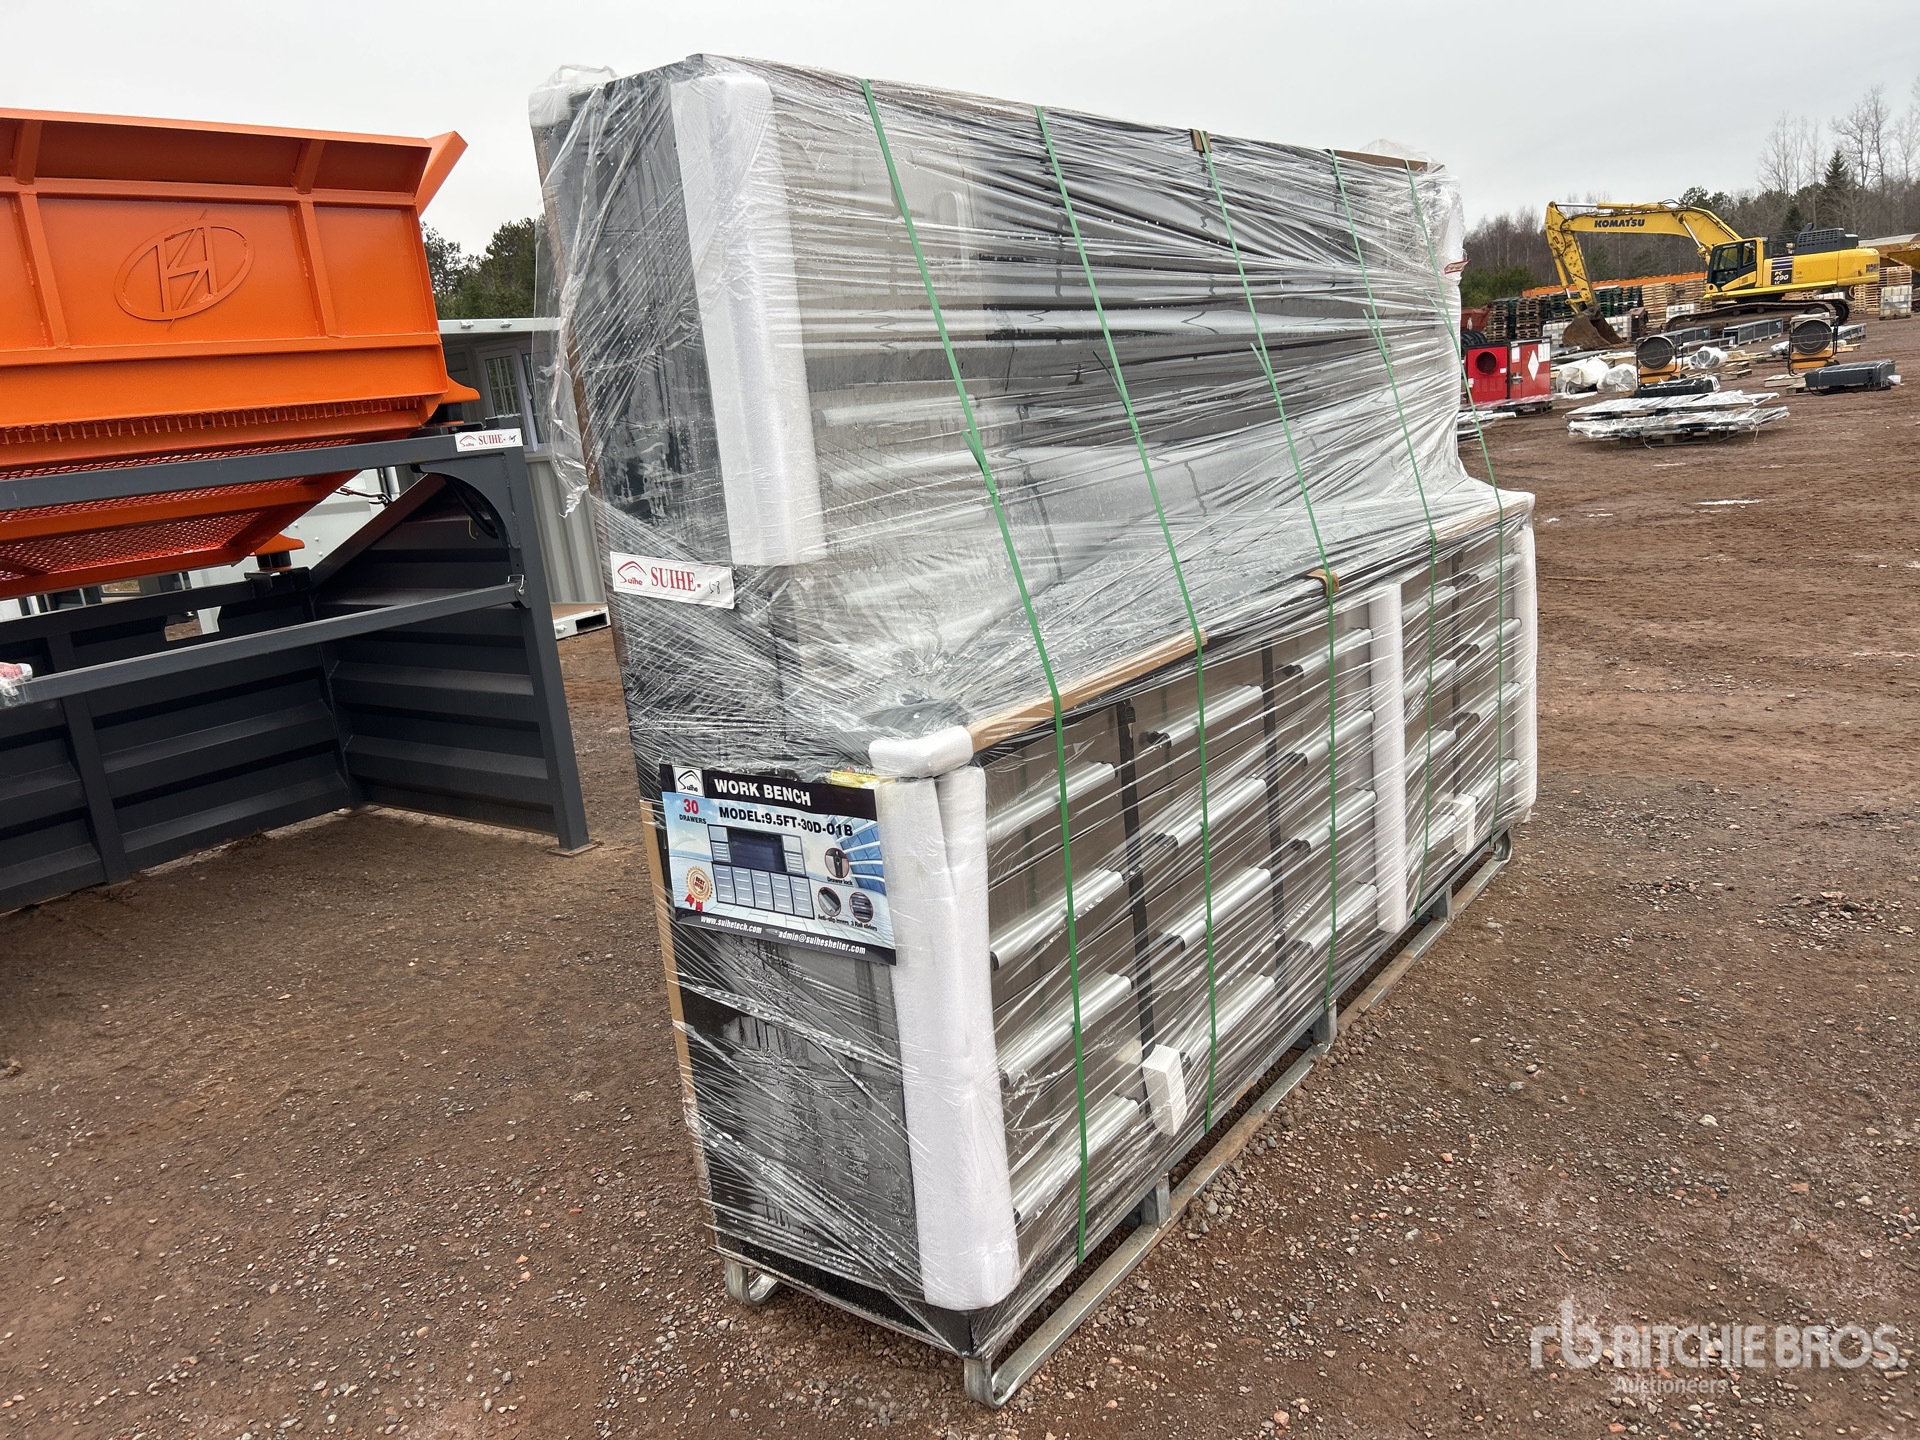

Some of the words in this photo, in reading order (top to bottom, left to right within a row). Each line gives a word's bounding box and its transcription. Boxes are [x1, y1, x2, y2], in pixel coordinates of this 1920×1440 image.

[1594, 217, 1645, 228] KOMATSU
[714, 778, 760, 797] WORK
[763, 784, 811, 806] BENCH
[683, 798, 699, 815] 30
[679, 814, 707, 825] DRAWERS
[701, 915, 762, 935] www.suihetech.com
[777, 930, 867, 955] admin@suiheshelter.com
